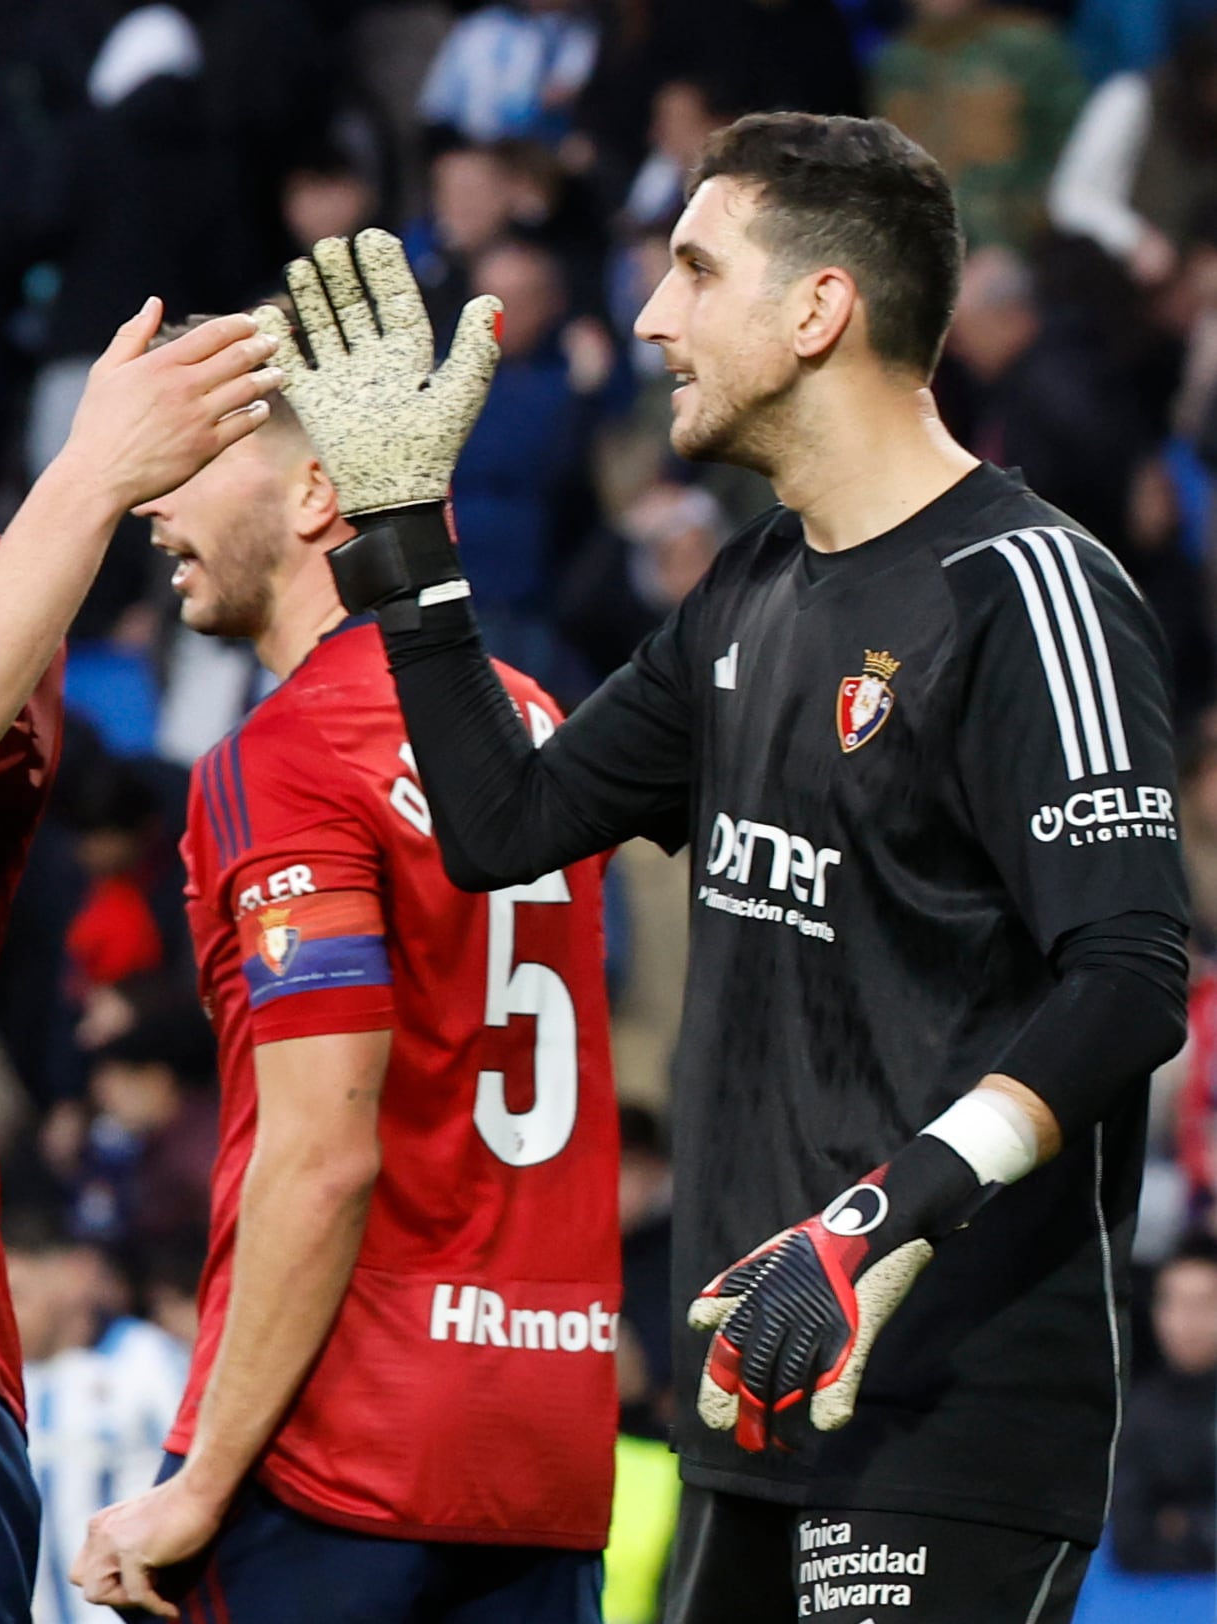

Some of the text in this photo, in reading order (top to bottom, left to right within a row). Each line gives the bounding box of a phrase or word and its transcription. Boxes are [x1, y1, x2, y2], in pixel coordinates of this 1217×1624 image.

[1064, 786, 1175, 827] CELER
[1069, 823, 1178, 847] LIGHTING
[473, 868, 578, 1168] 5
[799, 1545, 928, 1584] niversidad
[798, 1581, 912, 1618] e Navarra
